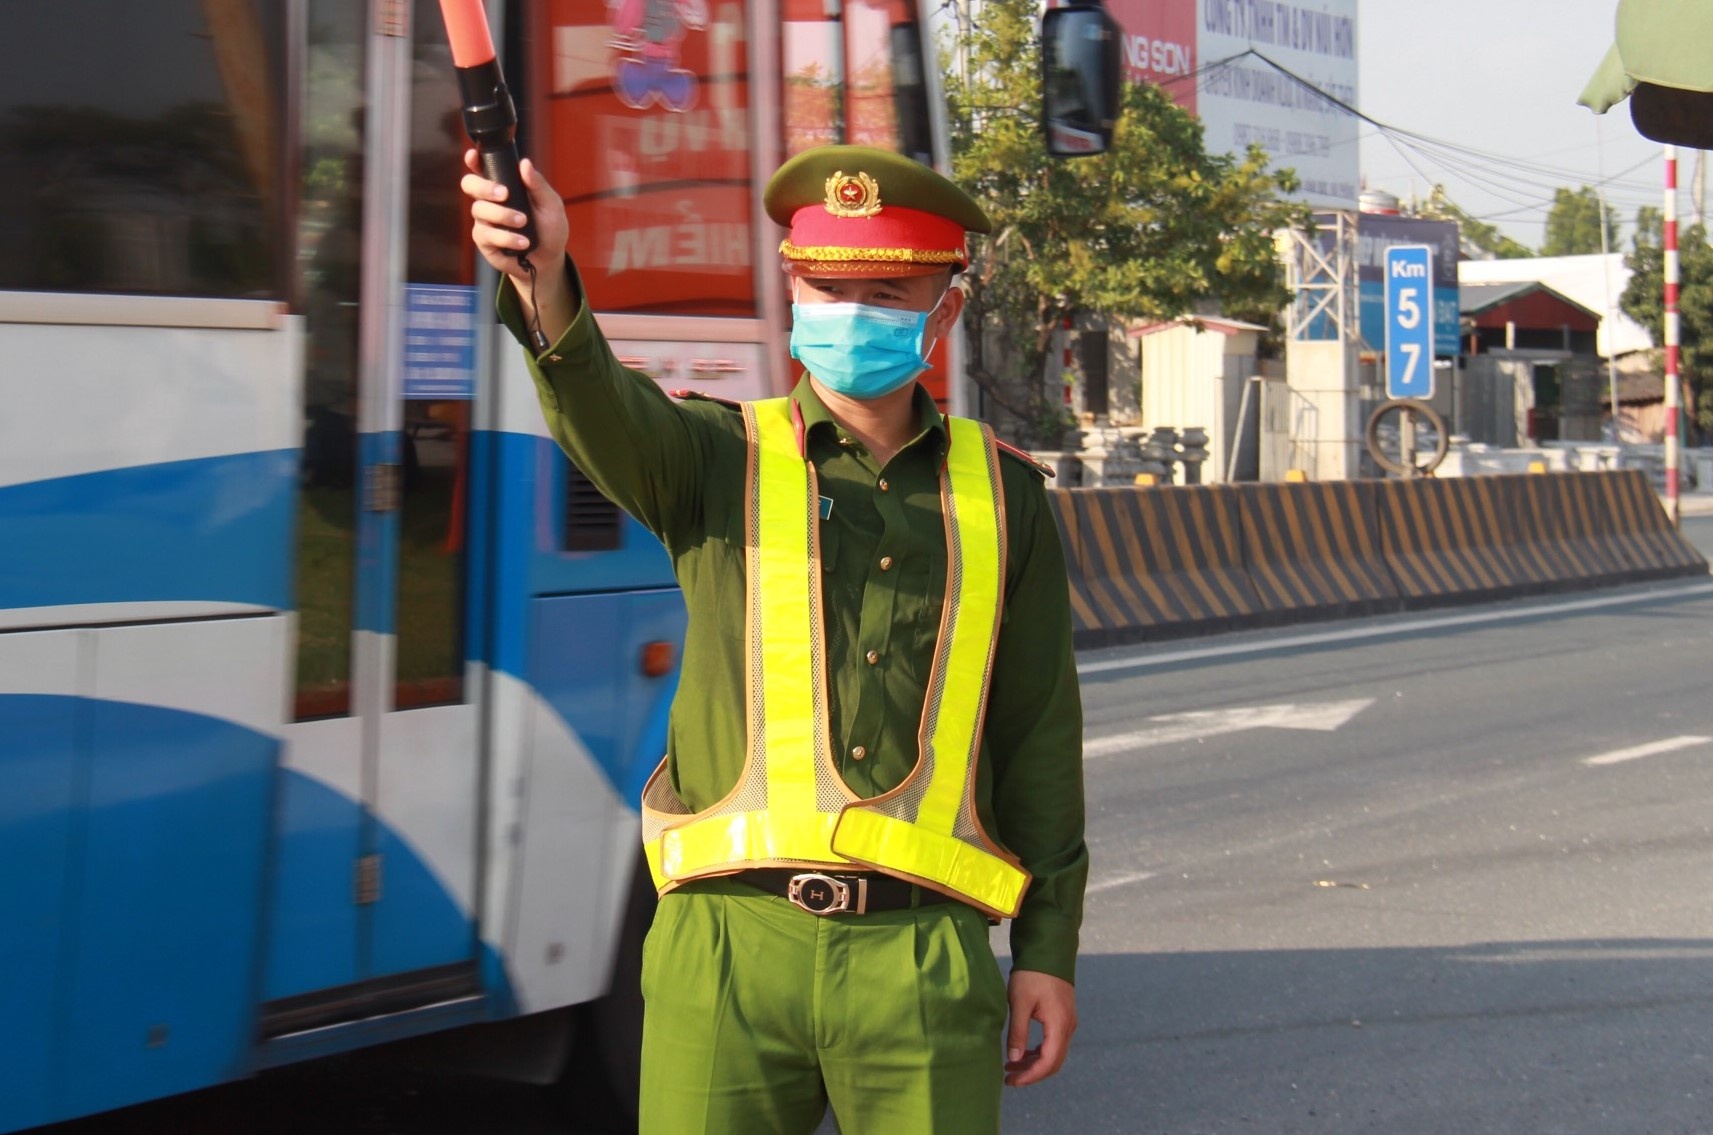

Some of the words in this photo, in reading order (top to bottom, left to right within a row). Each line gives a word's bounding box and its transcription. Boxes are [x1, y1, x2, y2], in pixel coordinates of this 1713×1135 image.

[1392, 260, 1425, 278] Km
[1397, 288, 1421, 329] 5
[1400, 344, 1421, 384] 7
